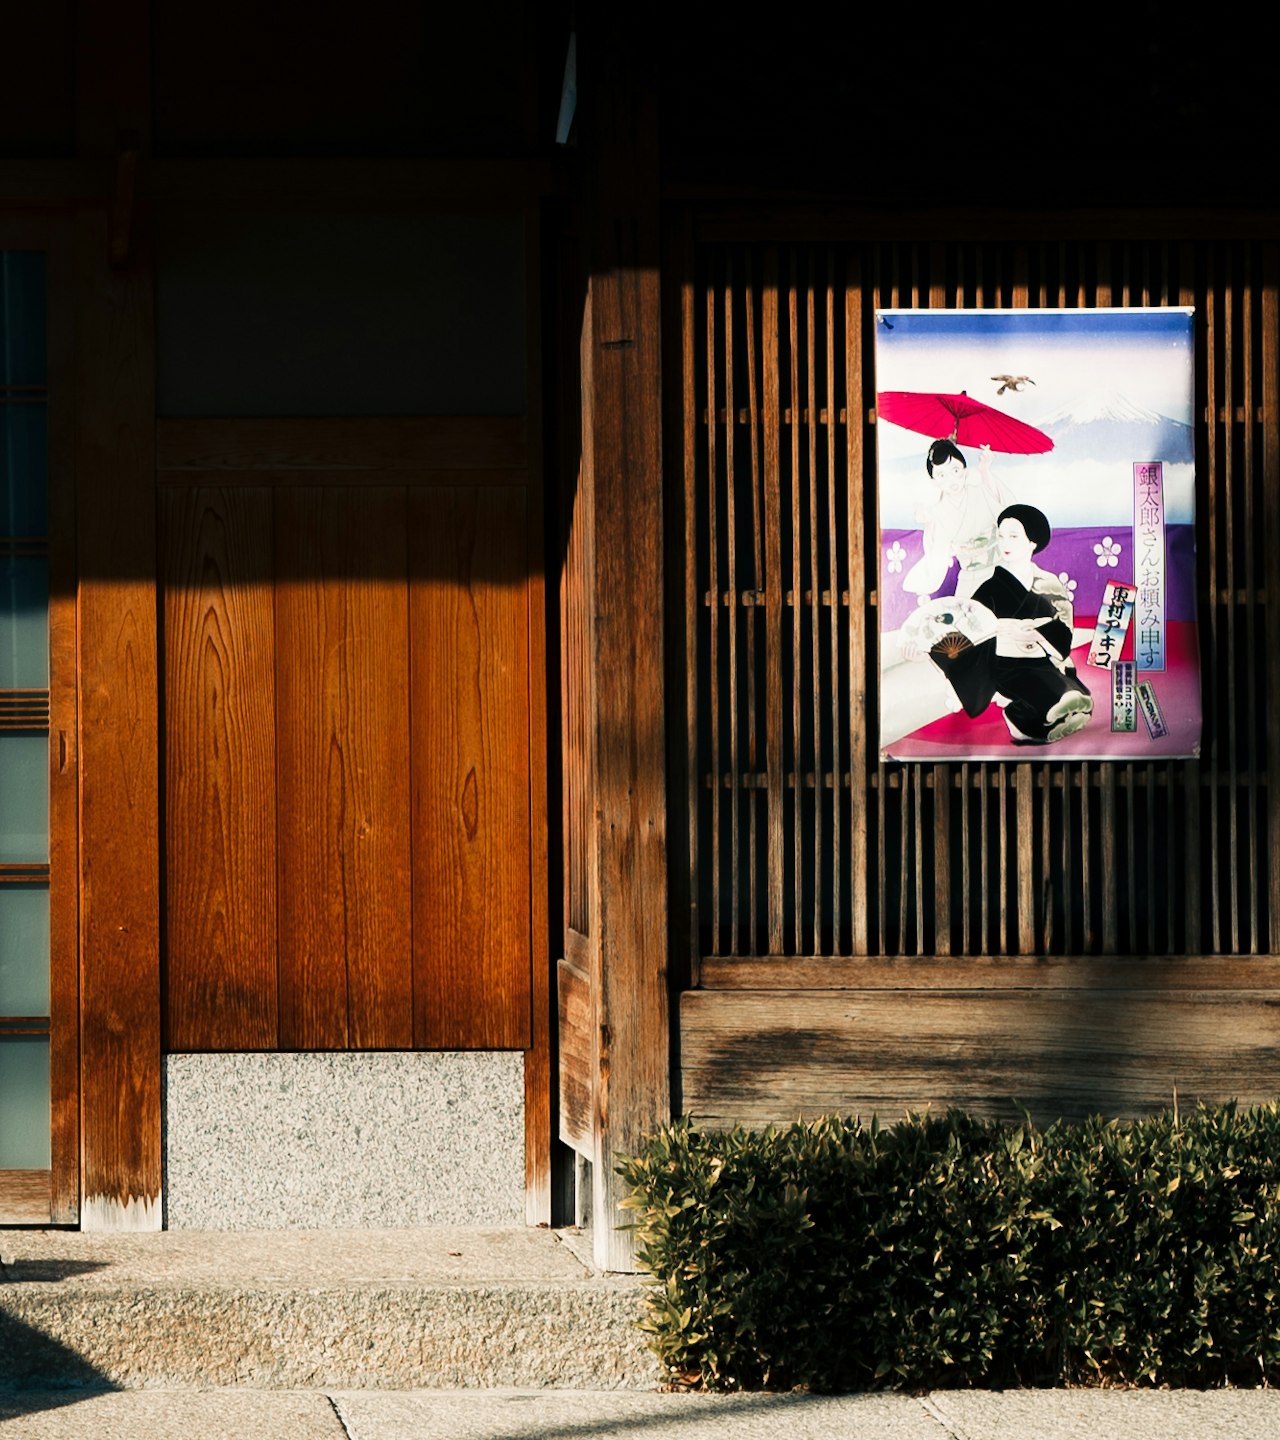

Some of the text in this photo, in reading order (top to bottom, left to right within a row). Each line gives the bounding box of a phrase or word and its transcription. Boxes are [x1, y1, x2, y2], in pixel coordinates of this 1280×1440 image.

[1095, 585, 1130, 668] 東村アキコ
[1138, 466, 1160, 669] 銀太郎さんお頼み申す
